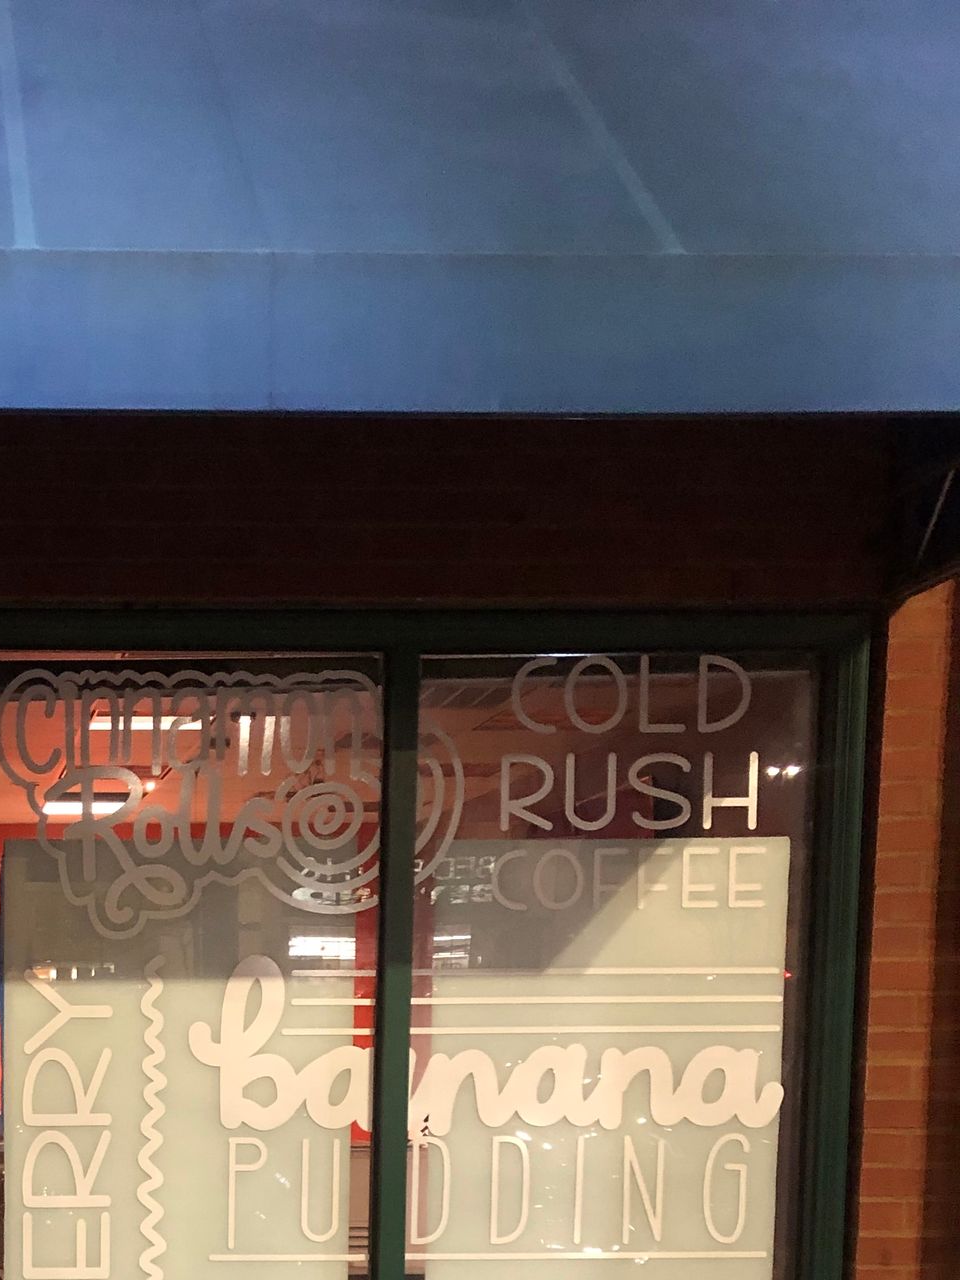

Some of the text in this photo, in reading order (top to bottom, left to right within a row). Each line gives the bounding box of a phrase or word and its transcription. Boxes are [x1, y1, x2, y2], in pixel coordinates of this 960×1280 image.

[16, 683, 366, 781] Cinnamon
[511, 655, 752, 734] COLD
[500, 751, 759, 832] RUSH
[43, 766, 283, 924] Rolls
[492, 847, 766, 911] COFFEE
[188, 954, 785, 1136] banana
[228, 1134, 751, 1250] PUDDING
